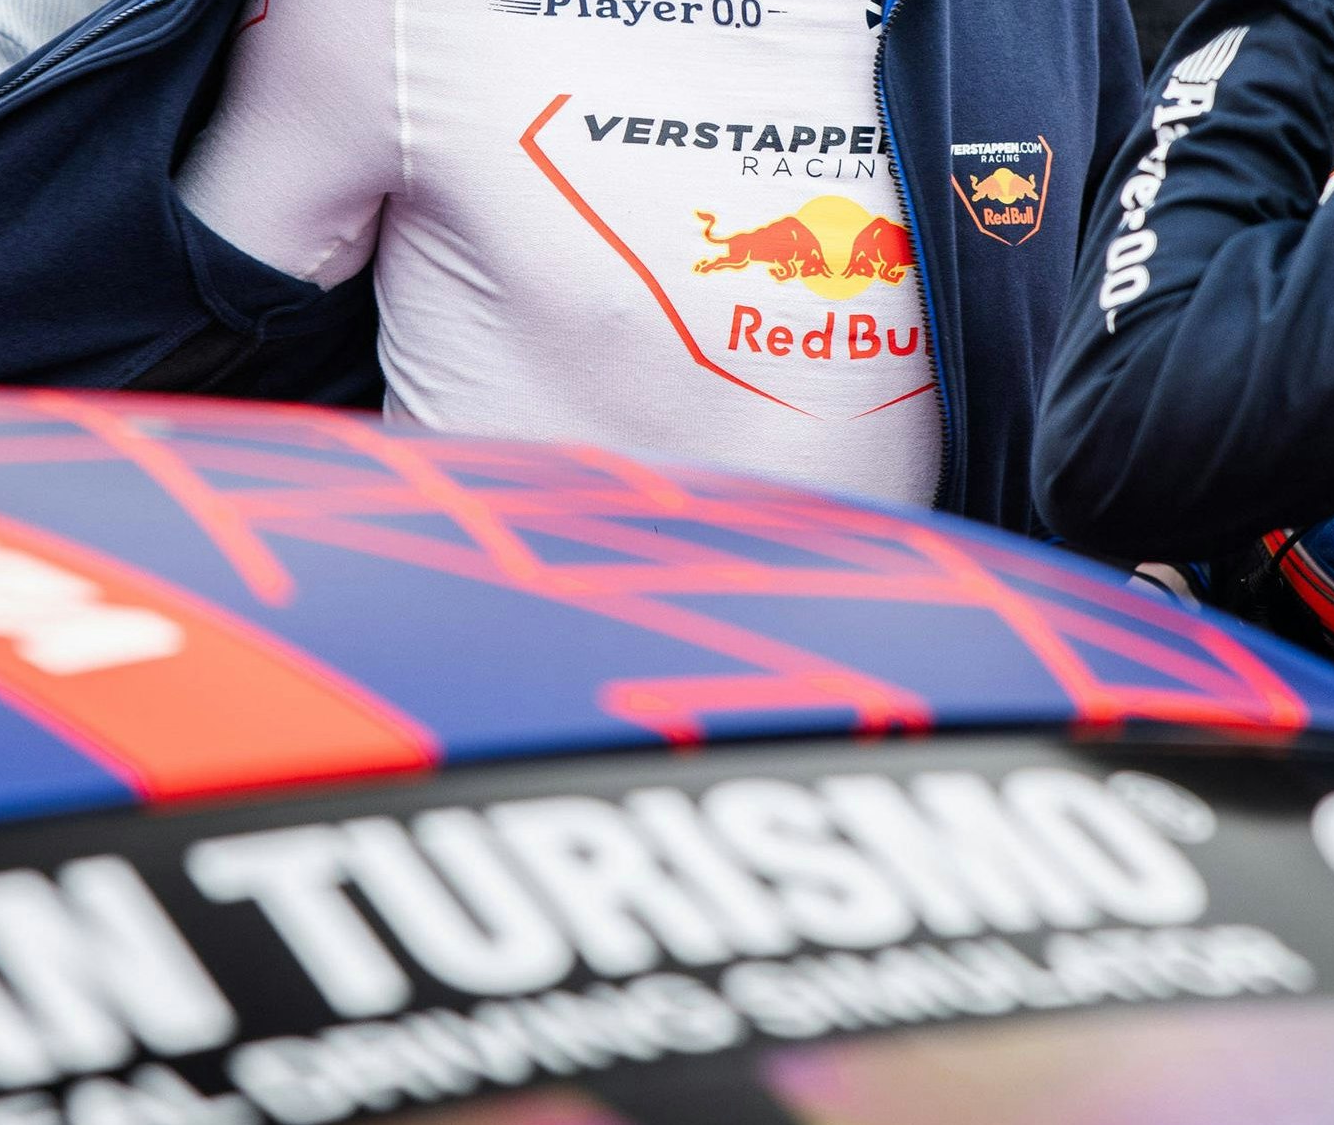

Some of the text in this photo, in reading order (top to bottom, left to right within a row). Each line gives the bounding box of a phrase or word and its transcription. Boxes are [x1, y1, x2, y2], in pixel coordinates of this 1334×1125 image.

[980, 154, 1021, 164] RACING
[983, 206, 1035, 226] Red Bull
[728, 304, 931, 360] Red Bu
[183, 765, 1215, 1021] TURISMO
